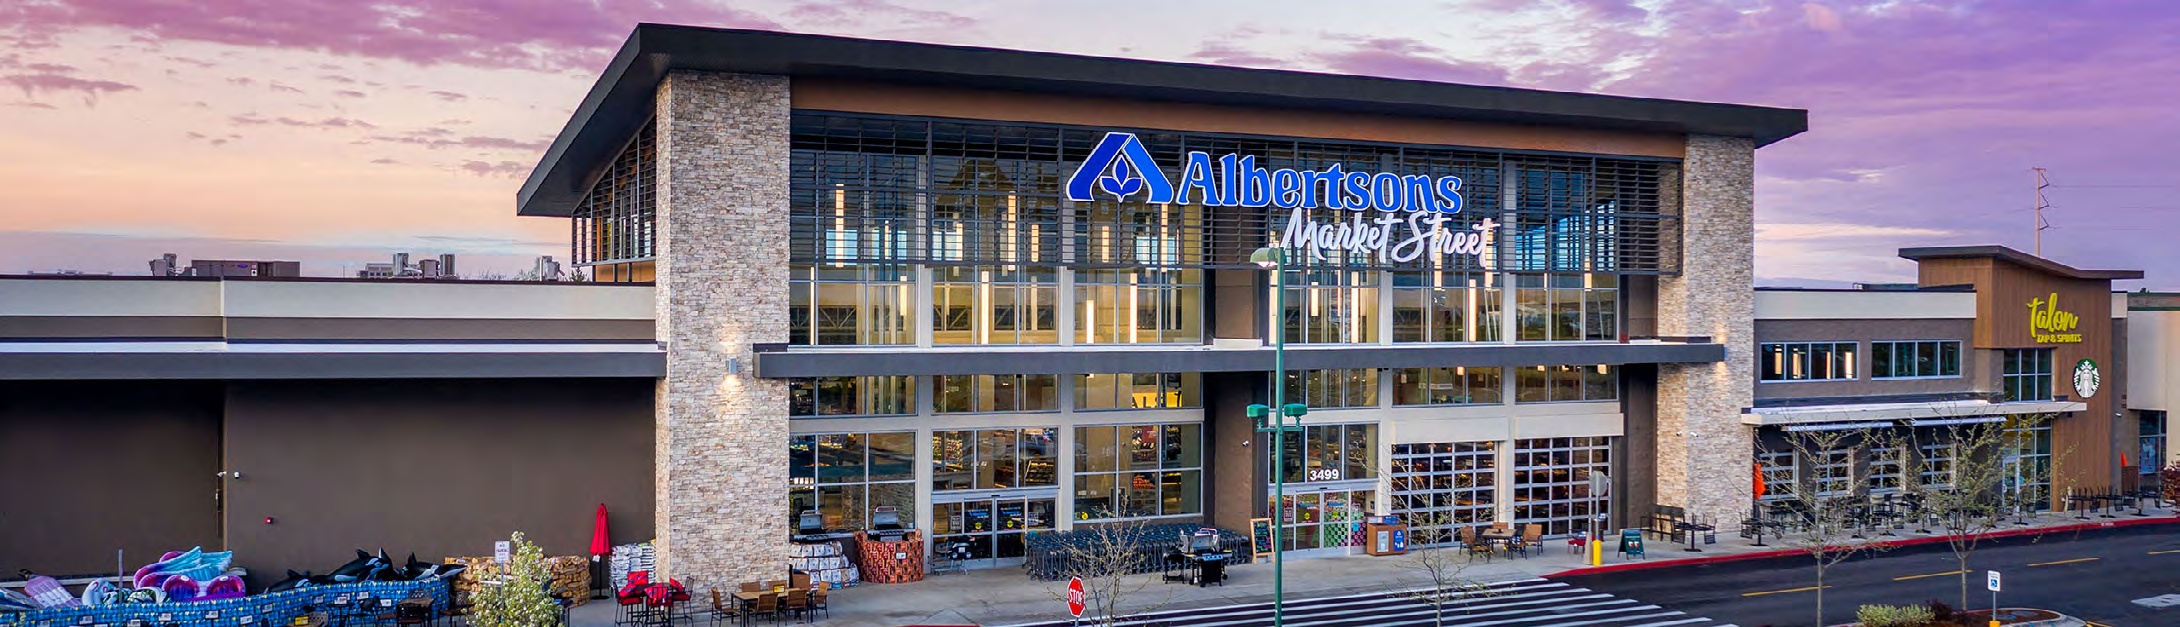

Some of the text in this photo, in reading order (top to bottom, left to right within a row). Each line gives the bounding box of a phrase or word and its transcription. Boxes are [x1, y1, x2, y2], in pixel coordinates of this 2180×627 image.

[1176, 150, 1463, 214] Albertsons
[1280, 207, 1501, 268] Market Street
[2026, 292, 2079, 338] talon
[2037, 334, 2082, 343] TAP & SPIRITS
[1310, 469, 1340, 480] 3499
[1069, 588, 1084, 605] STOP
